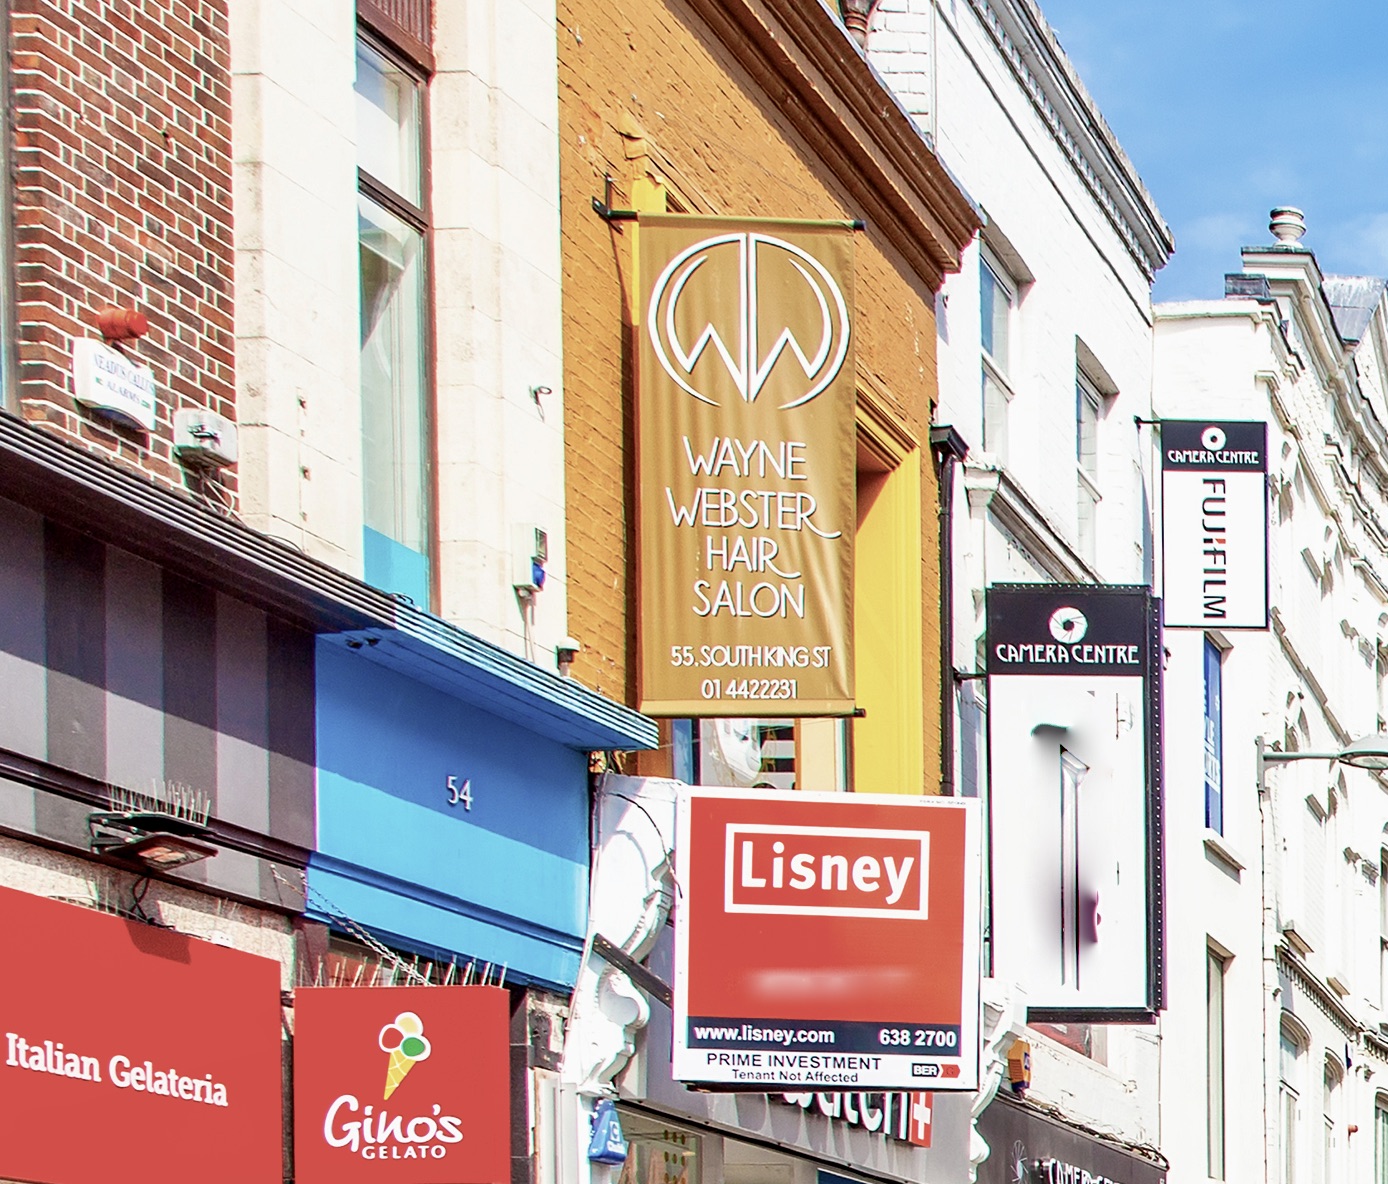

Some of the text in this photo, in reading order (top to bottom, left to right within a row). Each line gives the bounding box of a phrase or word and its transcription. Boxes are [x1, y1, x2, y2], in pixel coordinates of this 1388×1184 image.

[682, 435, 808, 480] WAYNE
[1168, 450, 1259, 464] CAMERA CENTRE
[665, 487, 842, 538] WEBSTER
[706, 536, 801, 578] HAIR
[1202, 478, 1226, 619] FUJIFILM
[692, 580, 804, 618] SALON
[700, 646, 763, 668] SOUTH
[764, 646, 809, 668] KING
[810, 646, 832, 668] ST
[996, 644, 1140, 666] CAMERA CENTRE
[702, 679, 797, 700] 01 4422231
[446, 776, 473, 811] 54
[742, 840, 915, 905] Lisney
[694, 1025, 957, 1047] www.lisney.com 638 2700
[6, 1032, 229, 1107] Italian Gelateria
[707, 1053, 882, 1071] PRIME INVESTMENT
[732, 1069, 858, 1083] Tenant Not Affected
[913, 1065, 938, 1077] BER
[324, 1094, 464, 1152] Gino's
[361, 1145, 447, 1160] GELATO
